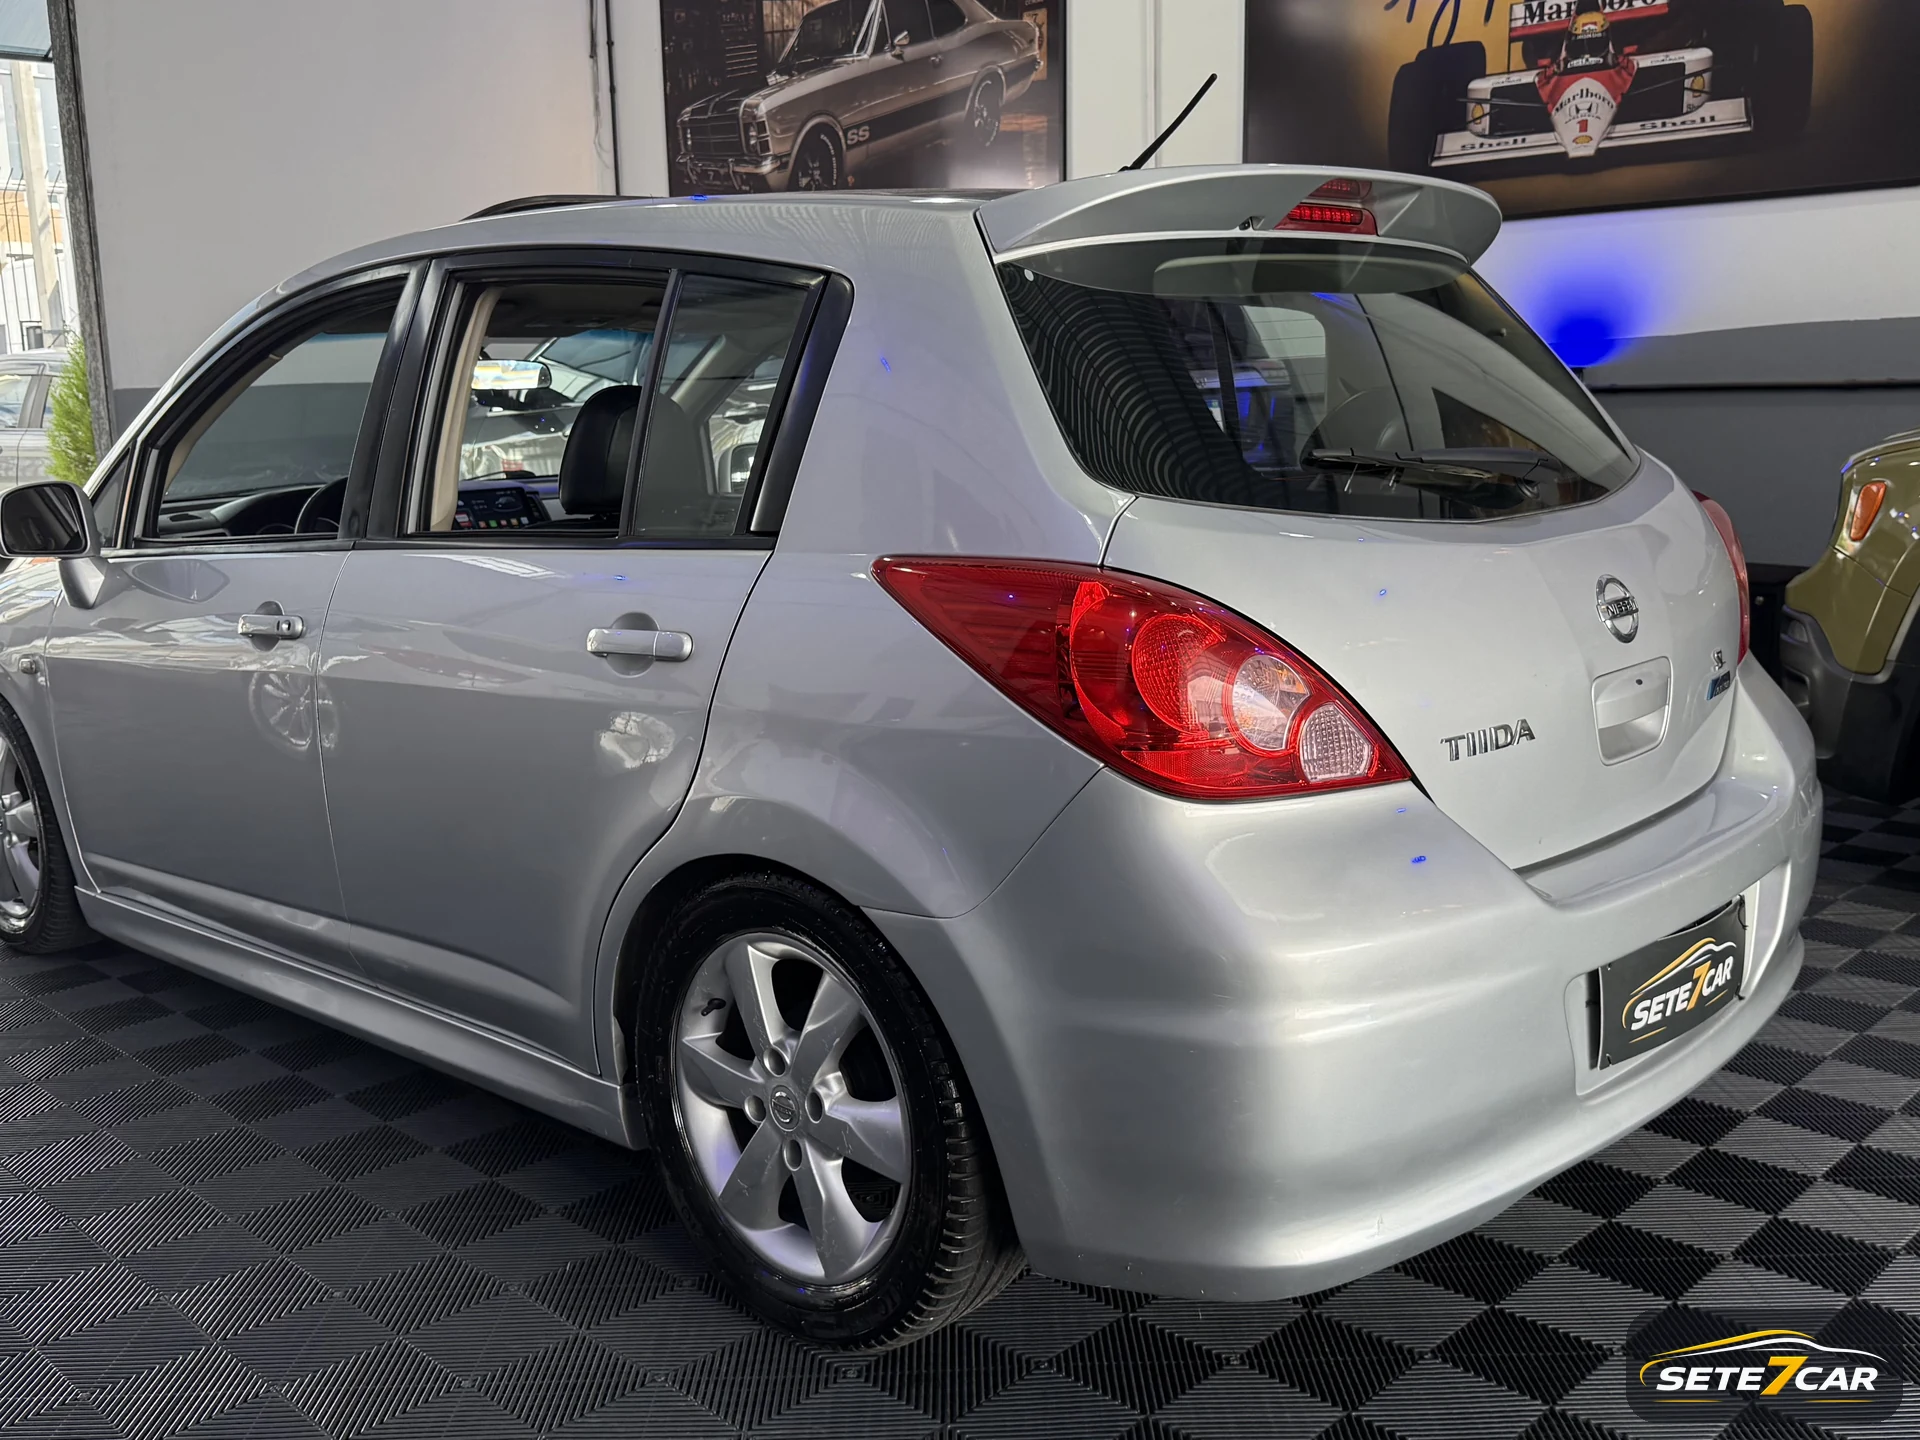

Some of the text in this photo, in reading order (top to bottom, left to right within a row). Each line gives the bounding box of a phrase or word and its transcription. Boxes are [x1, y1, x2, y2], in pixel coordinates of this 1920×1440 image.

[1523, 0, 1657, 25] Maror
[1576, 119, 1589, 133] 1
[1640, 116, 1715, 129] Shell
[847, 126, 870, 145] SS
[1461, 138, 1526, 151] Shell
[1441, 718, 1535, 761] TIIDA
[1630, 956, 1734, 1031] SETE7CAR
